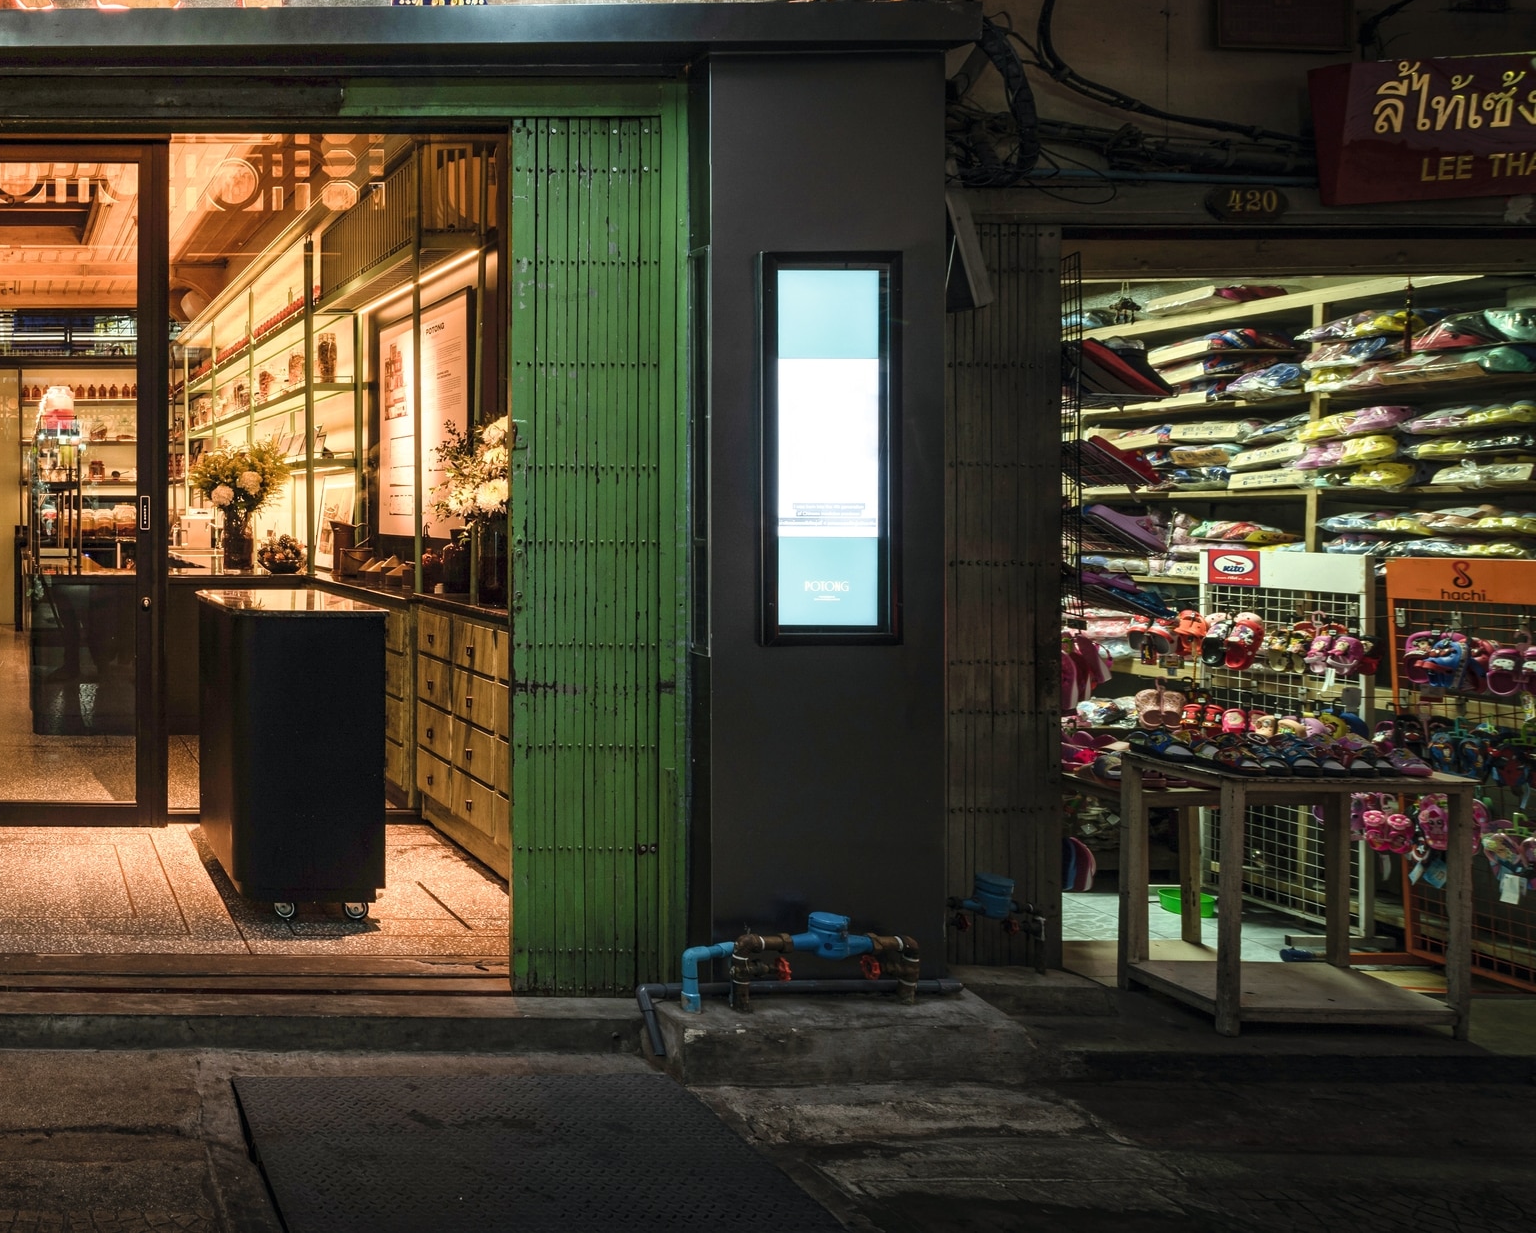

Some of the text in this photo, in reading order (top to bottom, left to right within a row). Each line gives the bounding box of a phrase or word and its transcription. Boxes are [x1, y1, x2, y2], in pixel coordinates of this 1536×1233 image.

[1421, 155, 1474, 182] LEE
[1227, 187, 1278, 213] 420
[425, 322, 445, 335] POTONG
[804, 580, 849, 592] POTONG
[1440, 588, 1486, 602] hachi
